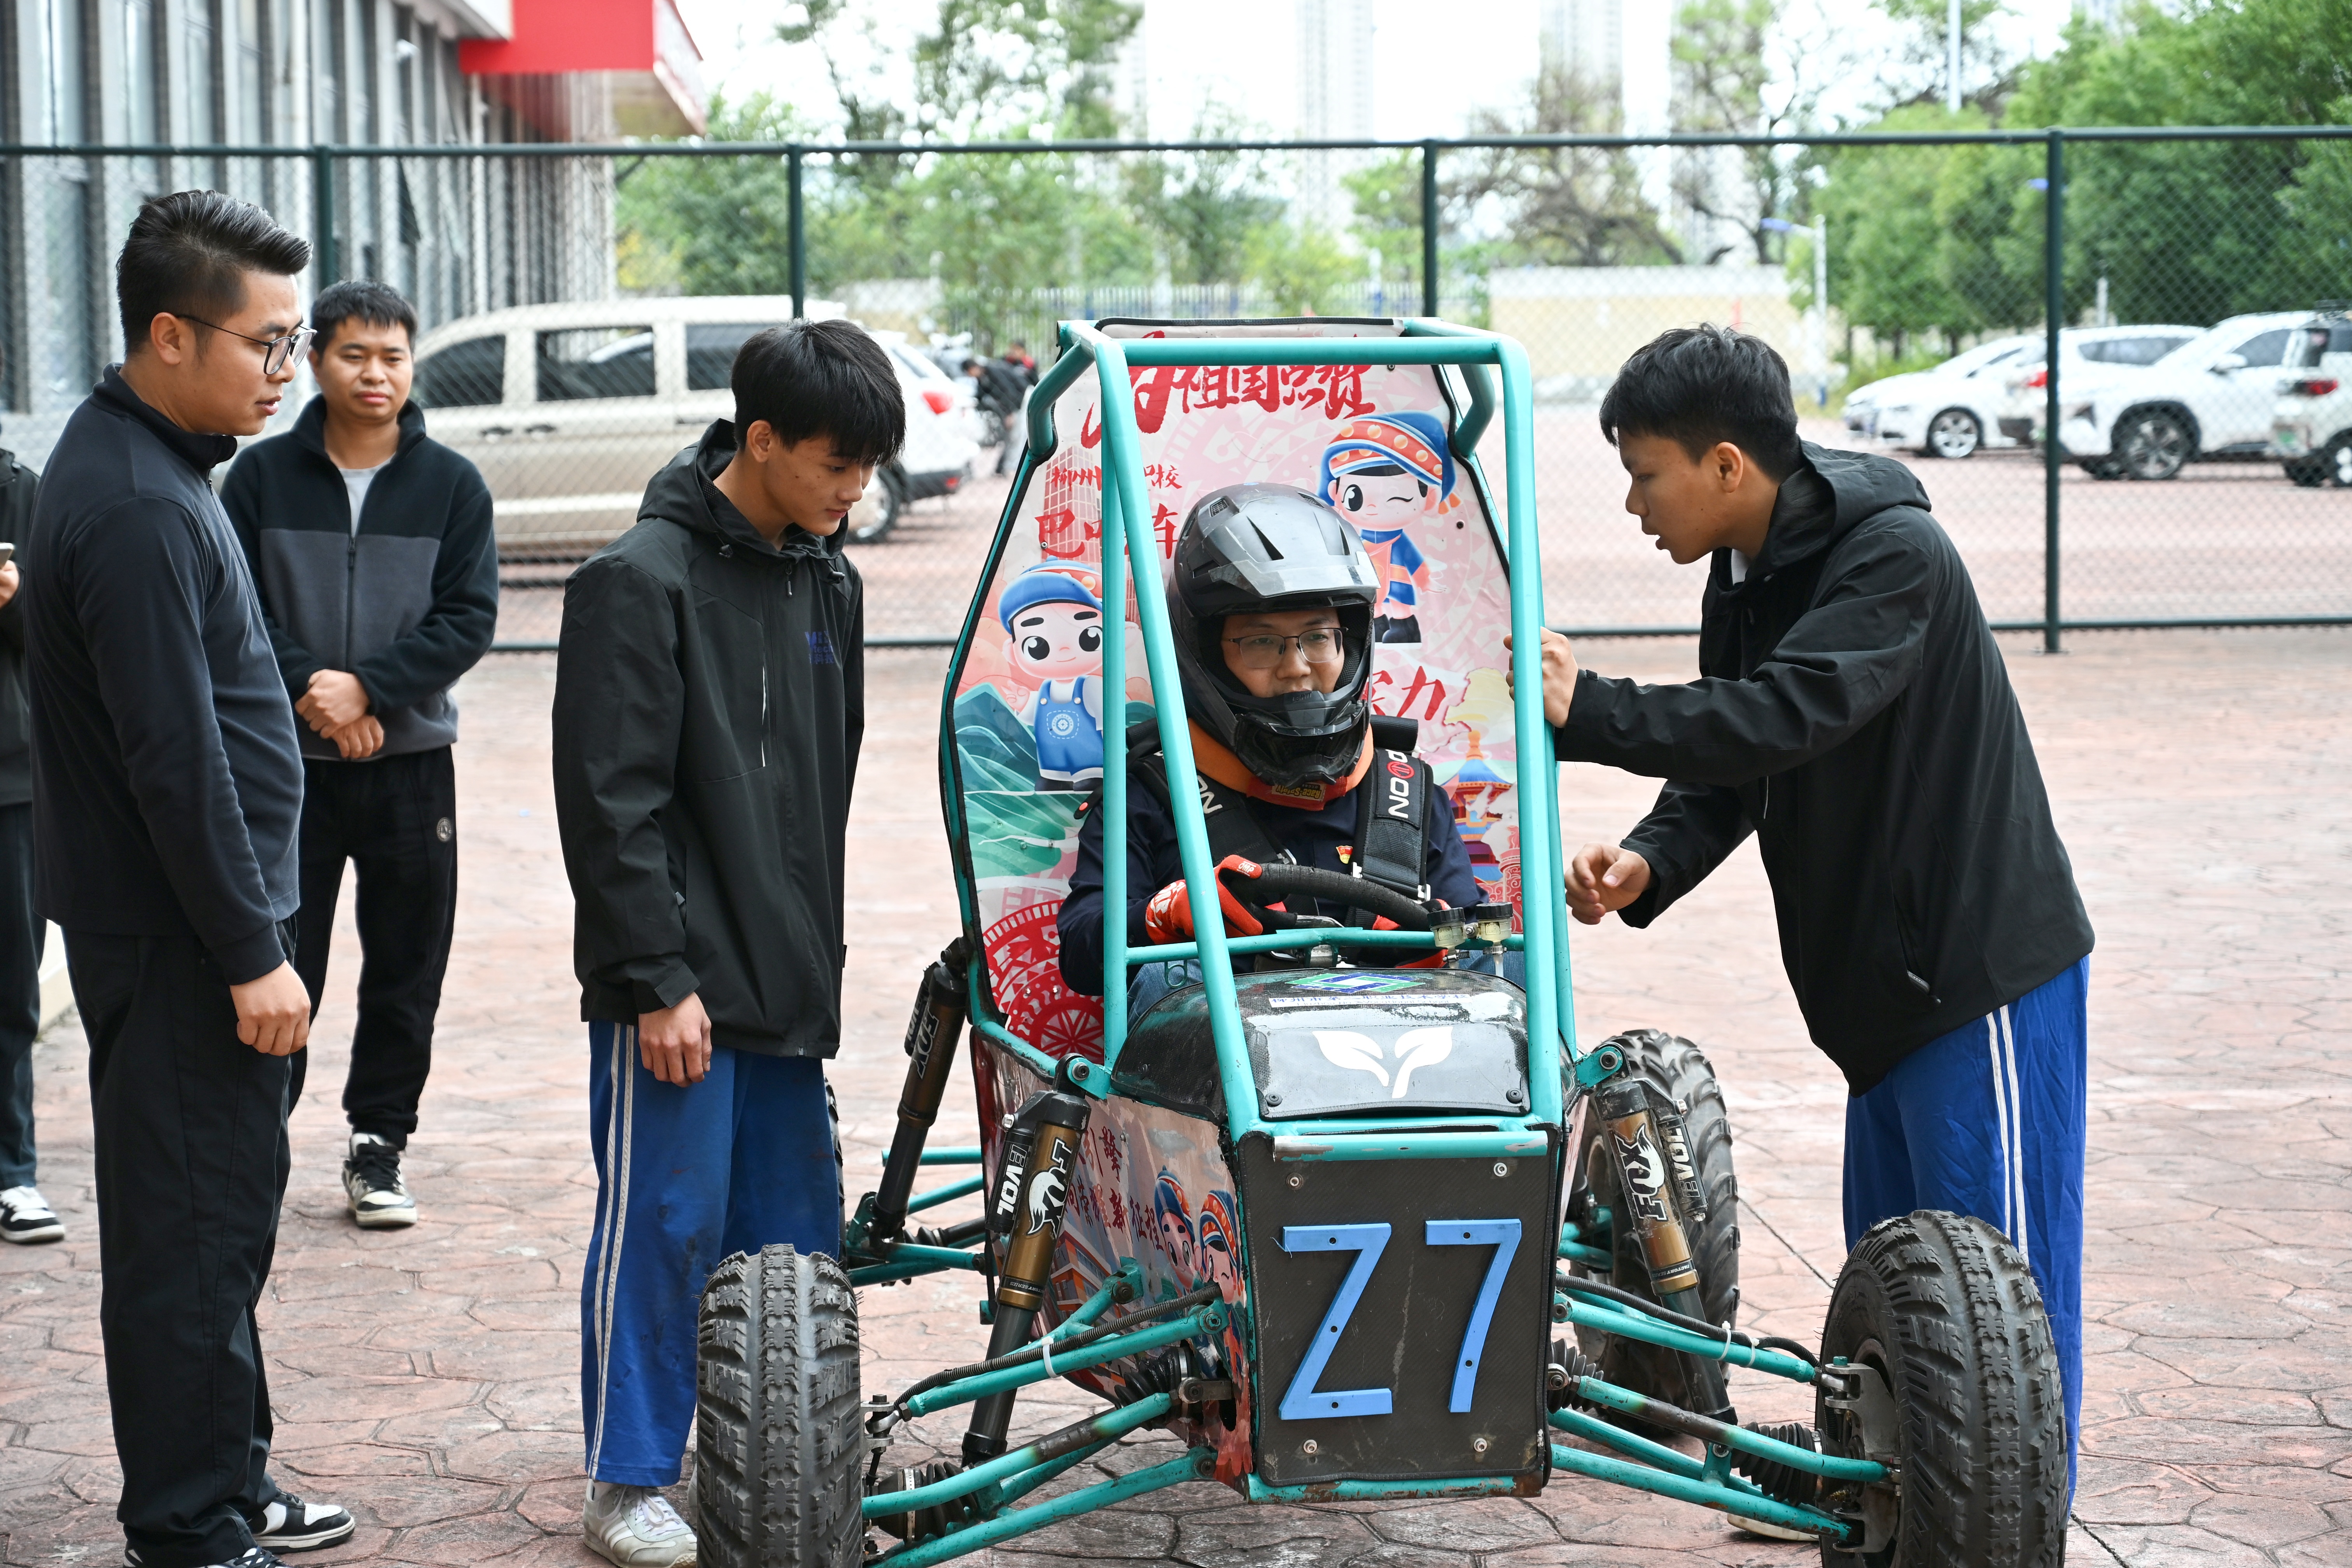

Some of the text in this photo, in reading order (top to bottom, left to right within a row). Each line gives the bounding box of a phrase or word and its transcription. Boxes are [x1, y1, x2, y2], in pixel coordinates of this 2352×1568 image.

[1238, 862, 1255, 873] OMP
[996, 1144, 1027, 1215] EVOL
[1614, 1124, 1668, 1221] FOX
[1009, 1281, 1029, 1290] SERIES
[1666, 1264, 1690, 1274] FACTORY
[1279, 1218, 1522, 1420] Z7
